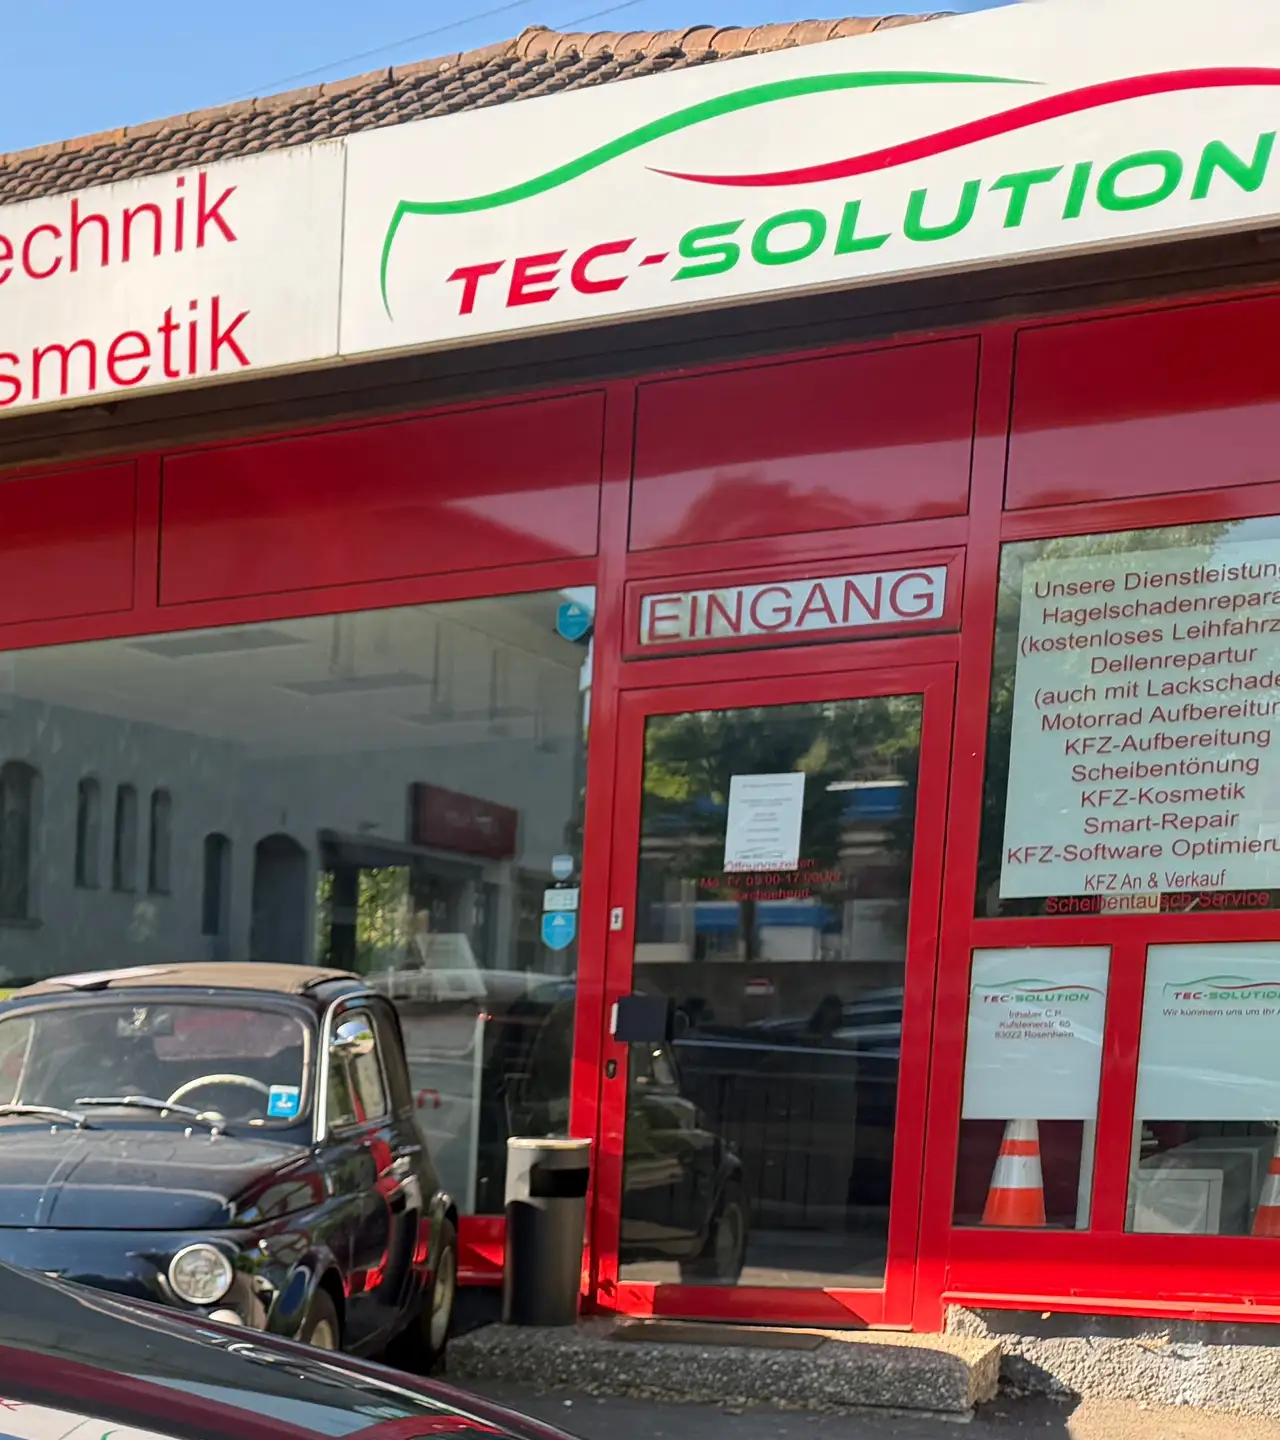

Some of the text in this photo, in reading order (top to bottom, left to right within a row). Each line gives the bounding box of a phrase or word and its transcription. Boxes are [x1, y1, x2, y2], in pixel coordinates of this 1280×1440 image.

[446, 131, 1277, 316] TEC-SOLUTION
[1034, 561, 1280, 599] Unsere Dienstleistun
[646, 571, 936, 643] EINGANG
[1021, 628, 1164, 657] (kostenloses
[1090, 646, 1258, 675] Dellenrepartur
[1034, 685, 1096, 711] (auch
[1104, 681, 1140, 701] mit
[1041, 707, 1143, 732] Motorrad
[1064, 728, 1271, 756] KFZ-Aufbereitung
[1071, 756, 1260, 783] Scheibentönung
[1080, 782, 1246, 808] KFZ-Kosmetik
[1083, 811, 1240, 835] Smart-Repair
[1007, 842, 1163, 865] KFZ-Software
[1083, 868, 1227, 891] KFZ An & Verkauf
[1174, 990, 1280, 1000] TEC-SOLUTIO
[1162, 1008, 1178, 1017] Wir
